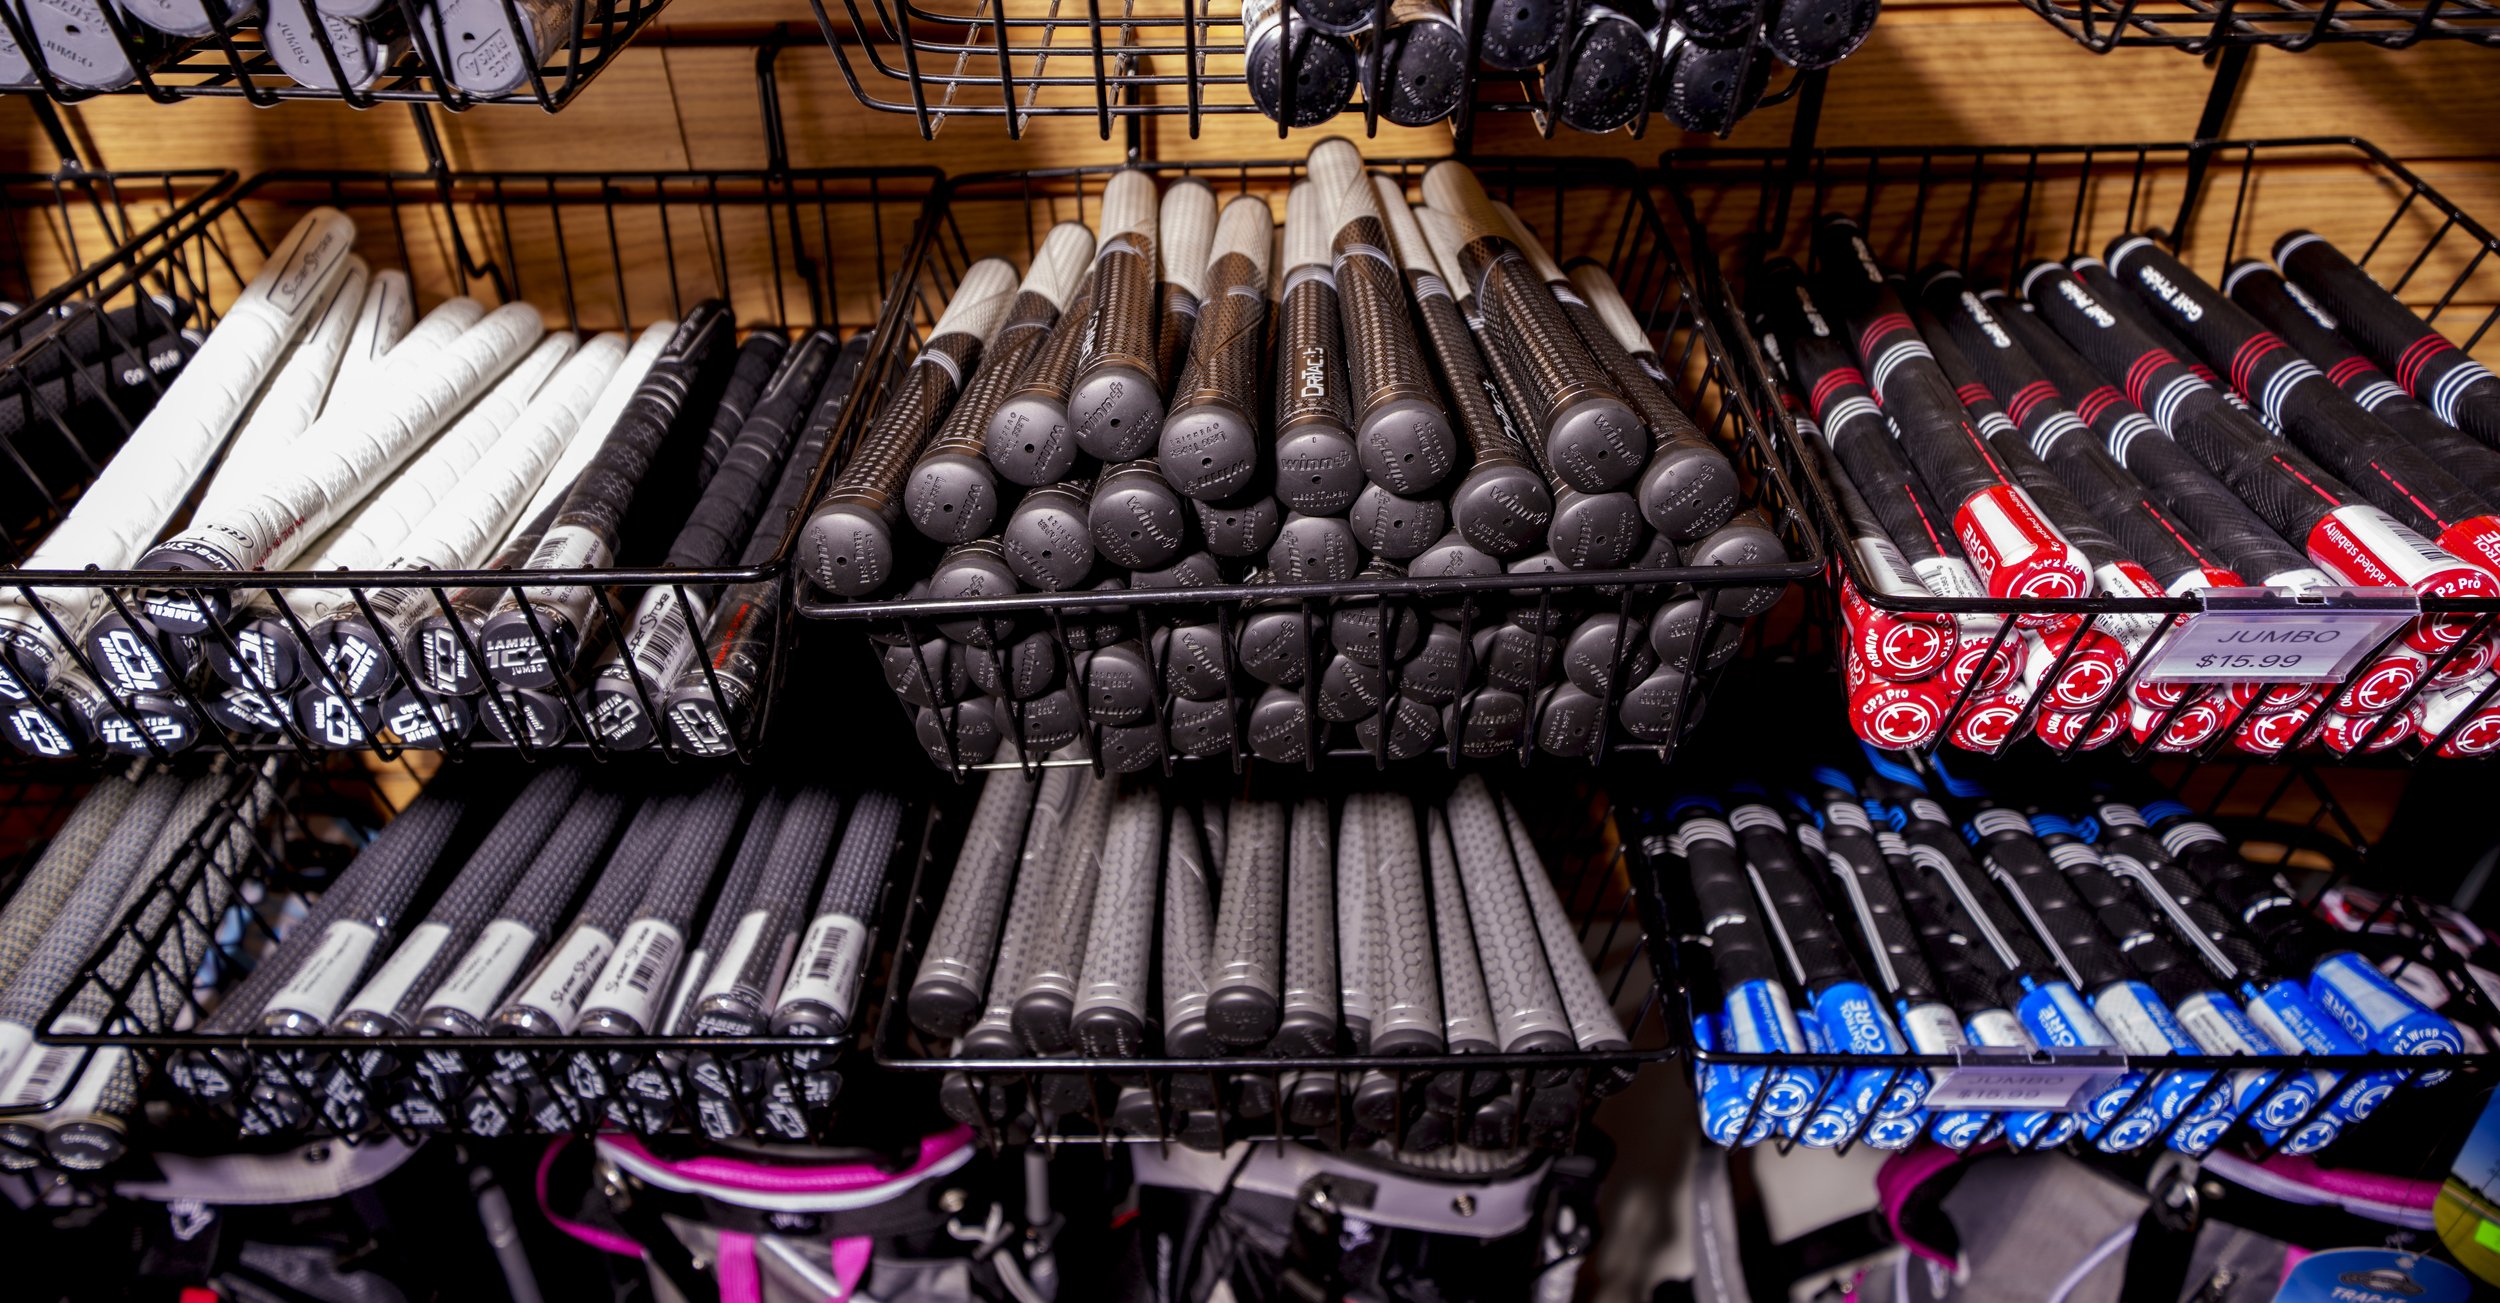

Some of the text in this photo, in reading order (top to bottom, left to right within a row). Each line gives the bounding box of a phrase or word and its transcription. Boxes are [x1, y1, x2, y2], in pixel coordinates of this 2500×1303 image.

[42, 39, 94, 68] JUMBO
[277, 21, 310, 66] JUMBO
[2056, 278, 2116, 329] Golf Pride
[2139, 264, 2205, 323] Golf Pride
[1076, 397, 1115, 438] winn
[1594, 414, 1629, 459] winn
[1035, 425, 1065, 470] winn
[1281, 453, 1333, 472] winn
[1198, 459, 1250, 488] winn
[1380, 447, 1409, 491] winn
[957, 484, 982, 528] winn
[1490, 486, 1535, 521] winn
[1656, 477, 1704, 515] winn
[2006, 489, 2032, 518] stability
[1127, 495, 1165, 541] winn
[1372, 506, 1389, 551] winn
[2026, 515, 2052, 541] added
[1573, 524, 1593, 567] winn
[1962, 522, 1996, 576] CORE
[2322, 521, 2388, 584] added stability
[818, 544, 837, 589] winn
[2062, 560, 2082, 576] Pro
[2434, 577, 2481, 598] P2 Pro
[148, 602, 209, 625] AMKIN
[1182, 632, 1218, 674] winn
[1865, 628, 1883, 669] JUMBO
[1936, 613, 1954, 659] CP2 Pro
[2218, 629, 2342, 644] JUMBO
[99, 637, 134, 691] LAMKIN
[422, 631, 436, 688] LAMKIN
[456, 649, 468, 679] JUMBO
[1020, 642, 1037, 685] winn
[2196, 653, 2303, 669] $15.99
[1340, 662, 1369, 701] winn
[1862, 688, 1909, 715] CP2 Pro
[611, 720, 638, 742] JUMBO
[704, 709, 728, 736] JUMBO
[1253, 718, 1296, 743] winn
[700, 1016, 752, 1034] LAMKIN
[1839, 1000, 1863, 1054] CONTROL
[1849, 998, 1886, 1054] CORE
[2042, 1003, 2077, 1047] ORE
[2322, 988, 2370, 1044] CORE
[2406, 1027, 2441, 1047] Wrap
[1967, 1075, 2065, 1087] JUMBO
